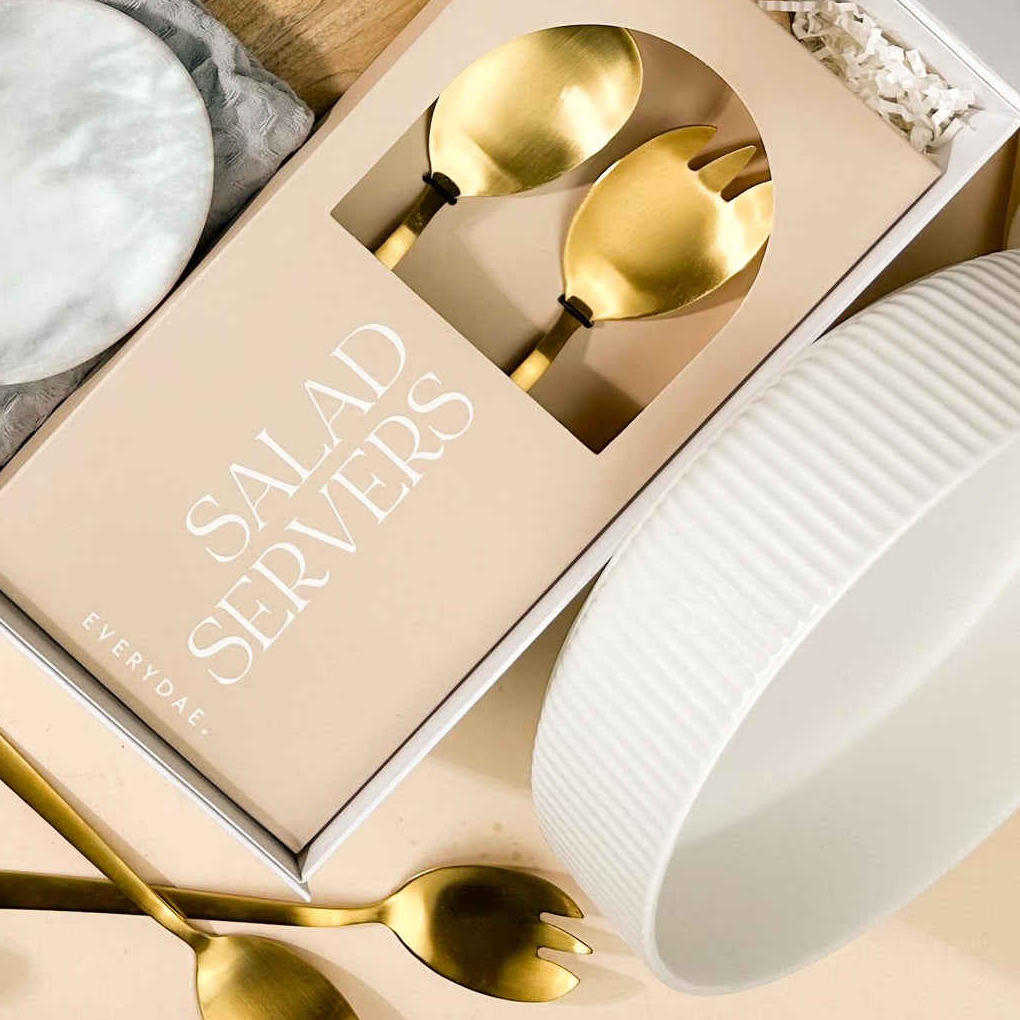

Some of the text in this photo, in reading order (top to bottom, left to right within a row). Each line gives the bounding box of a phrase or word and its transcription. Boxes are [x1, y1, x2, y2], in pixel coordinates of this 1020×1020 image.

[186, 323, 406, 563] SALAD
[187, 371, 474, 685] SERVERS
[81, 611, 207, 736] EVERYDAE.
